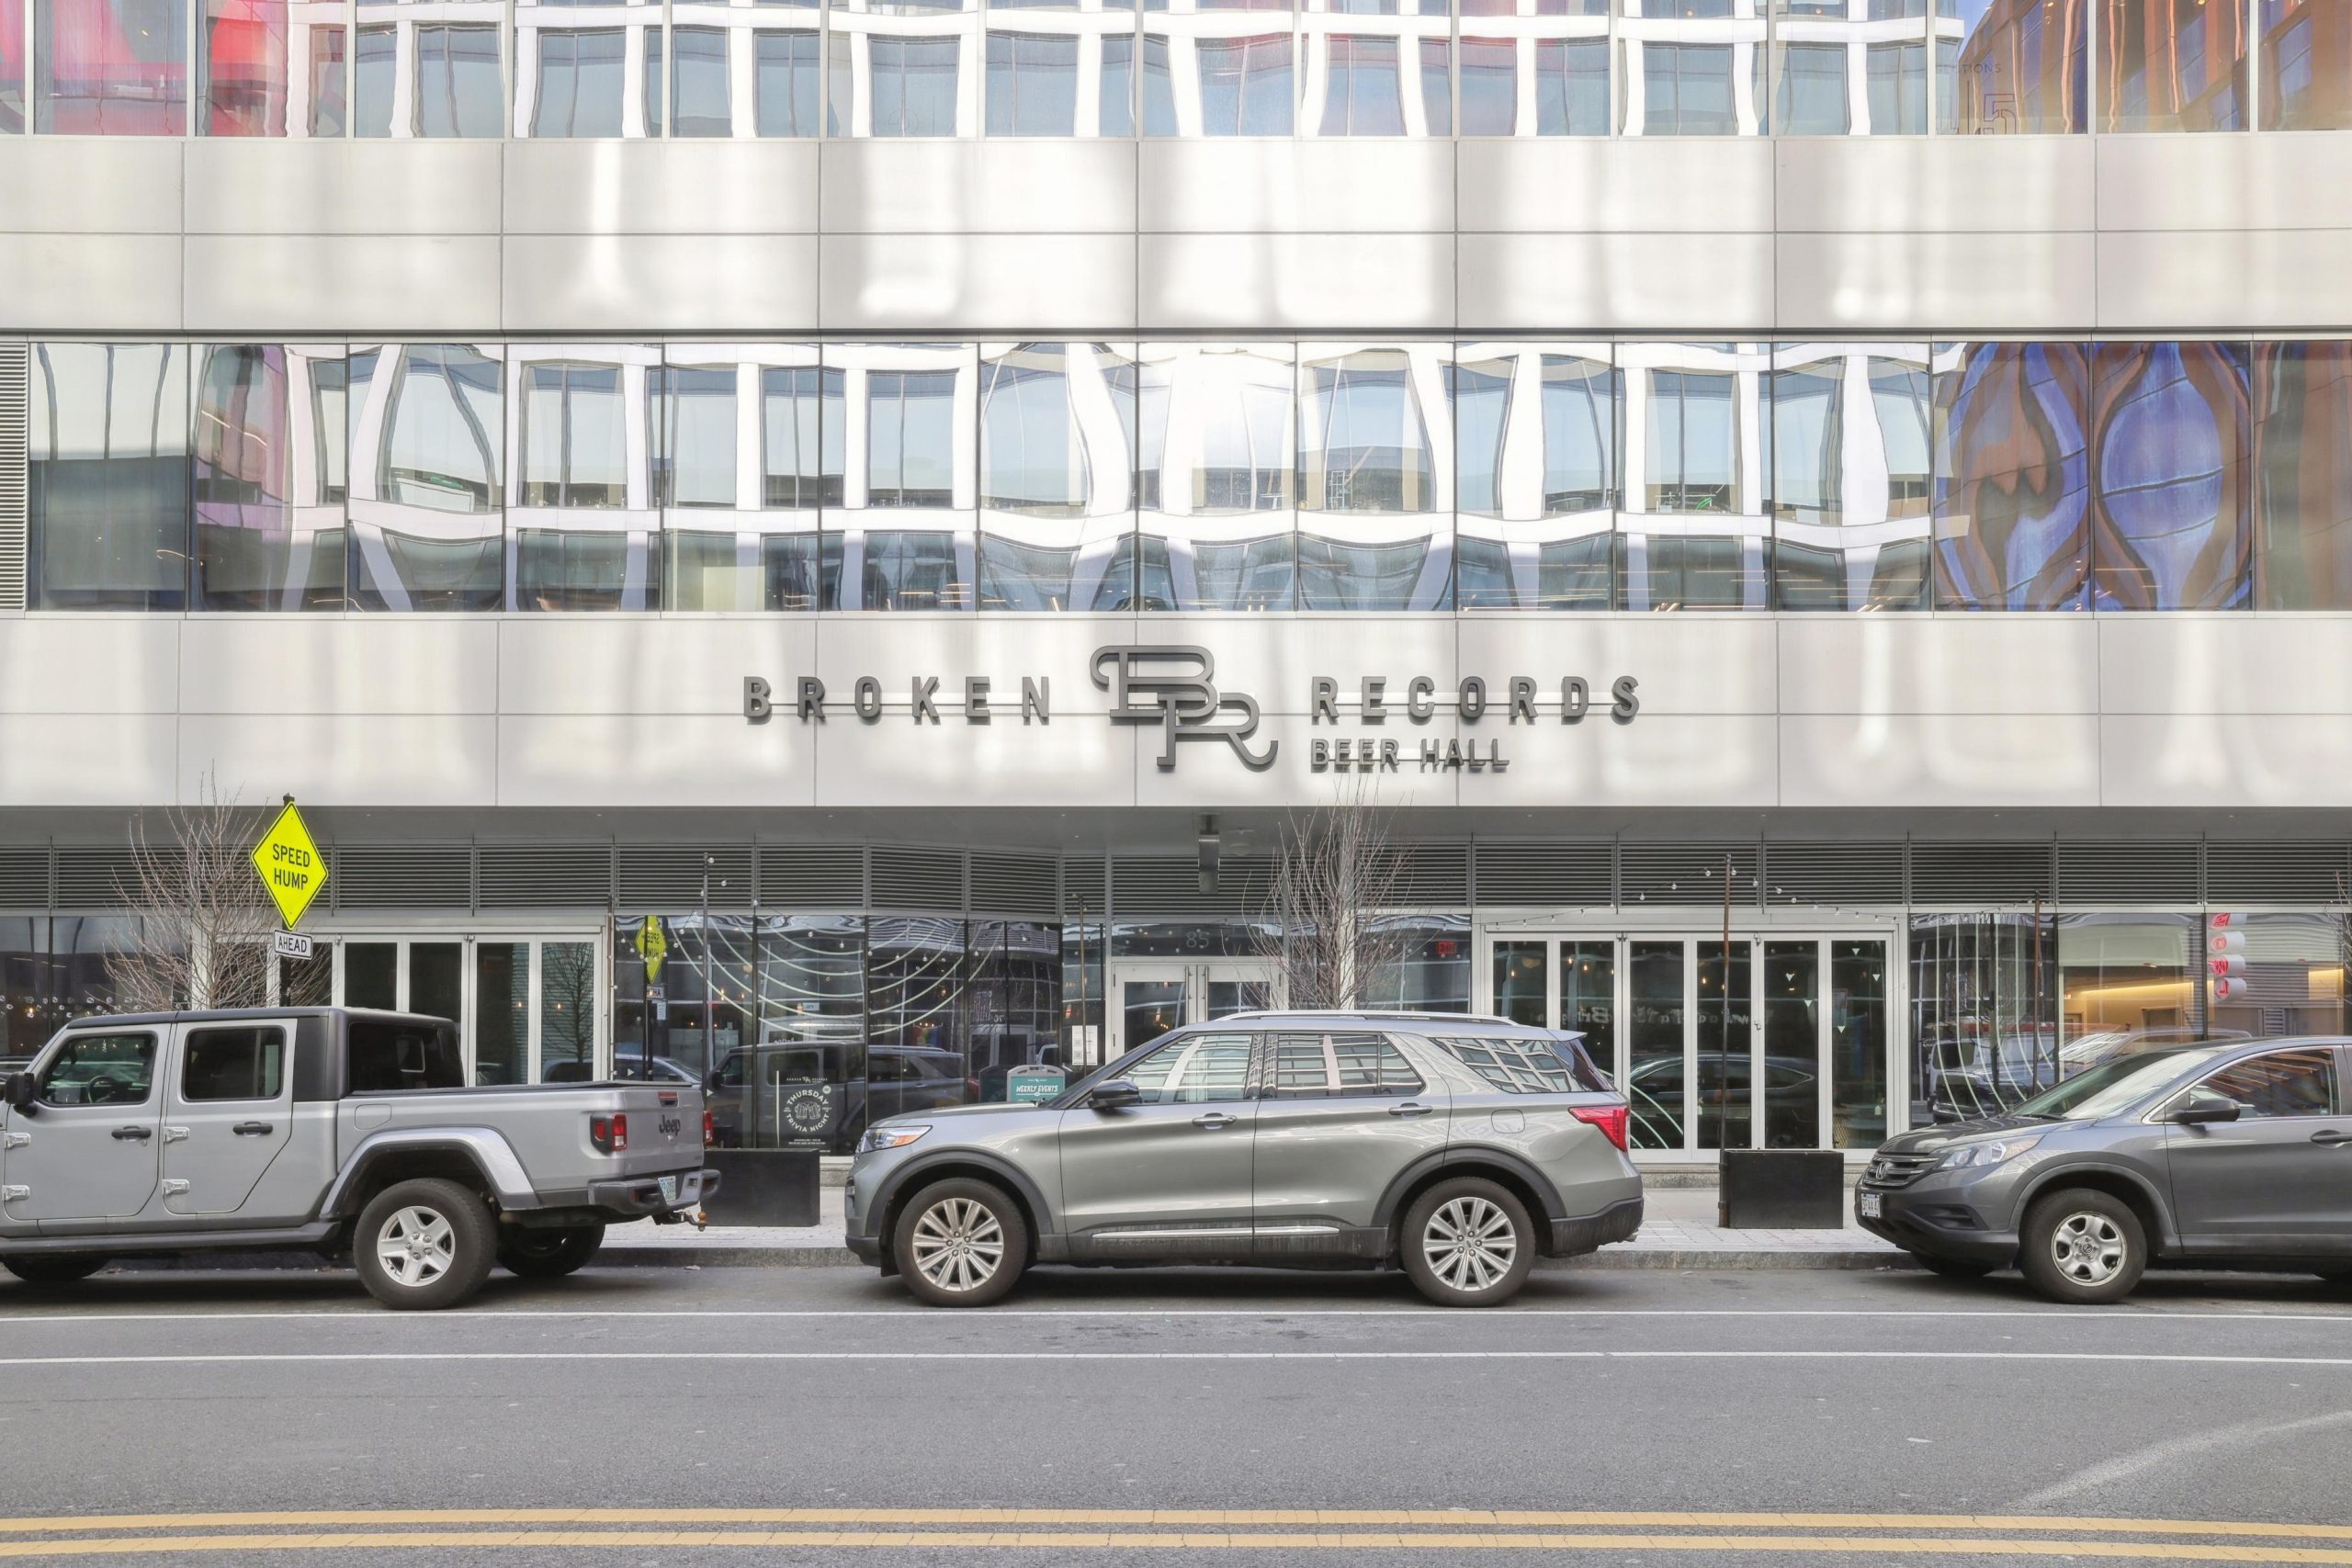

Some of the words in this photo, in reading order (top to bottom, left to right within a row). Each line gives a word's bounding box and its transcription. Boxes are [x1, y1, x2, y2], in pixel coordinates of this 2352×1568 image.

[743, 676, 1050, 721] BROKEN
[1311, 676, 1640, 720] RECORDS
[1310, 738, 1400, 768] BEER
[1420, 738, 1510, 768] HALL
[272, 843, 311, 868] SPEED
[274, 867, 309, 891] HUMP
[277, 935, 308, 953] AHEAD
[1185, 931, 1209, 948] 85
[786, 1089, 830, 1106] THURSDAY
[1015, 1085, 1036, 1093] WEEKLY
[1037, 1085, 1059, 1093] EVENTS
[659, 1114, 681, 1136] Jeep
[786, 1113, 808, 1134] TRIVIA
[809, 1113, 830, 1133] NIGHT
